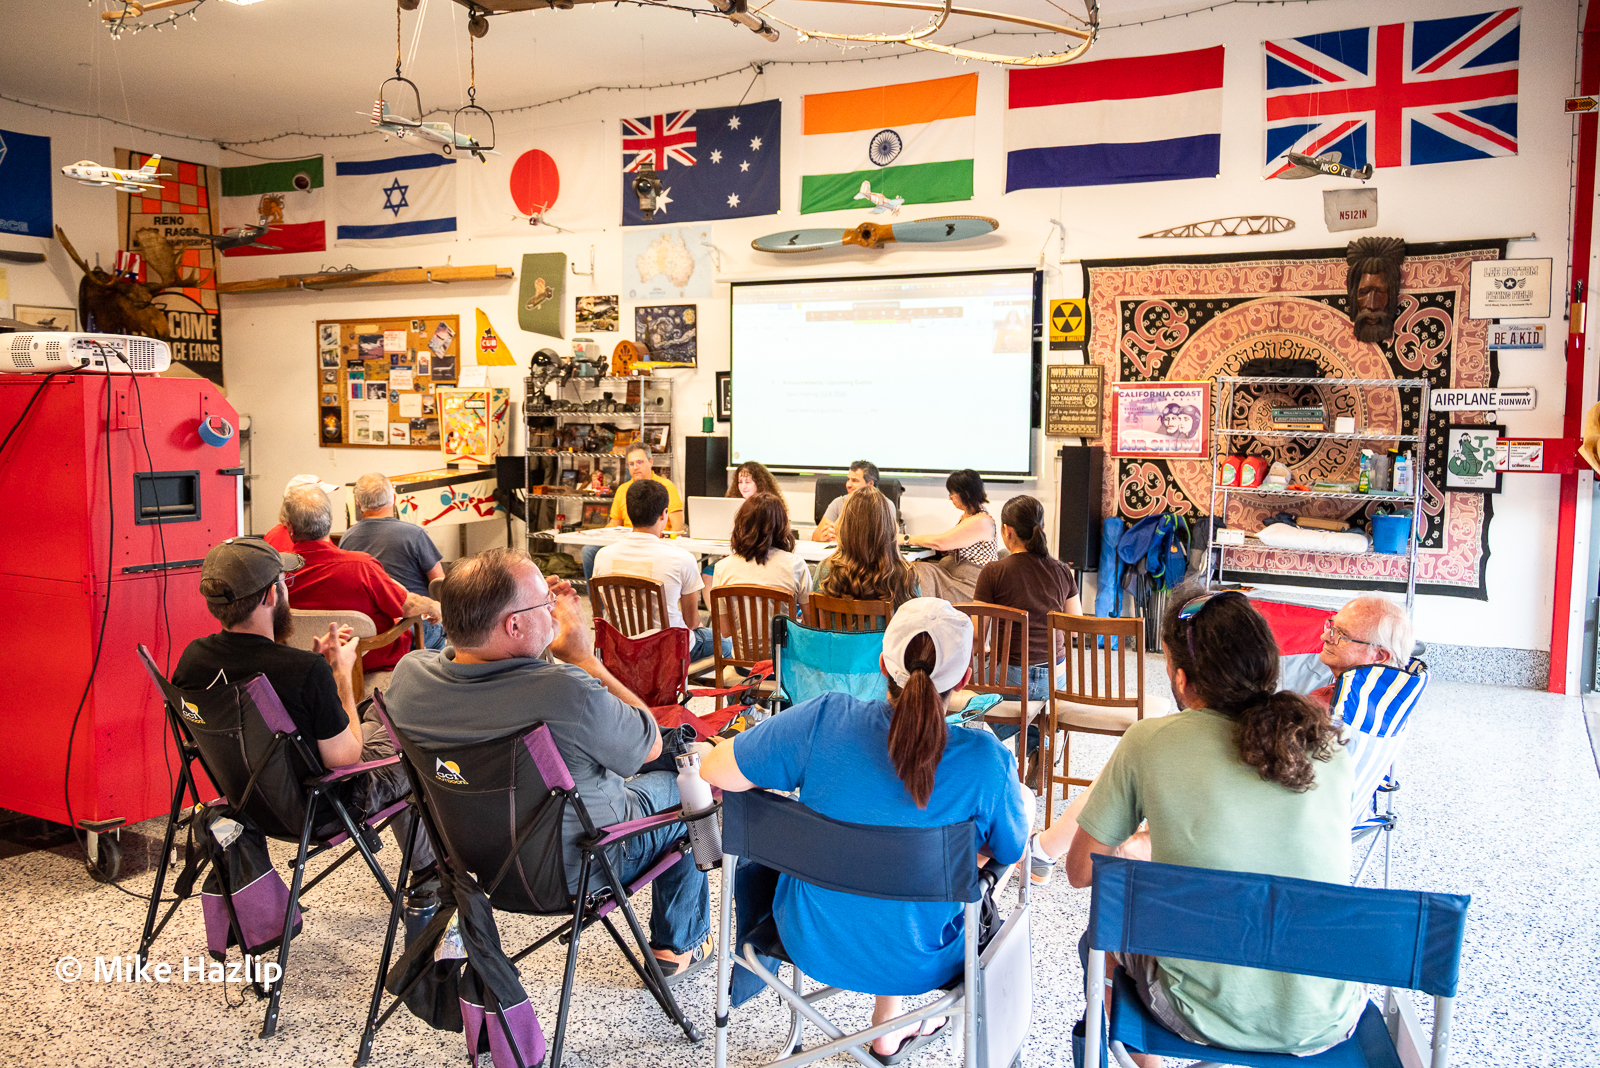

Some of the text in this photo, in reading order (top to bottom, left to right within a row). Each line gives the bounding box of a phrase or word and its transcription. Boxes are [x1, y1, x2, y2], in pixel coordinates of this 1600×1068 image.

[1320, 163, 1347, 177] NK K
[1340, 209, 1367, 220] N5121N
[154, 216, 184, 225] RENO
[165, 227, 199, 237] RACES
[1484, 266, 1539, 277] LEE BOTTOM
[1486, 290, 1534, 300] FLYING FIELD
[168, 312, 217, 340] COME
[1494, 332, 1539, 344] BE A KID
[189, 342, 220, 362] FANS
[1067, 368, 1082, 376] NIGHT
[1083, 368, 1098, 376] RULES
[1435, 393, 1531, 406] AIRPLANE RUNWAY
[1119, 439, 1147, 451] AIR
